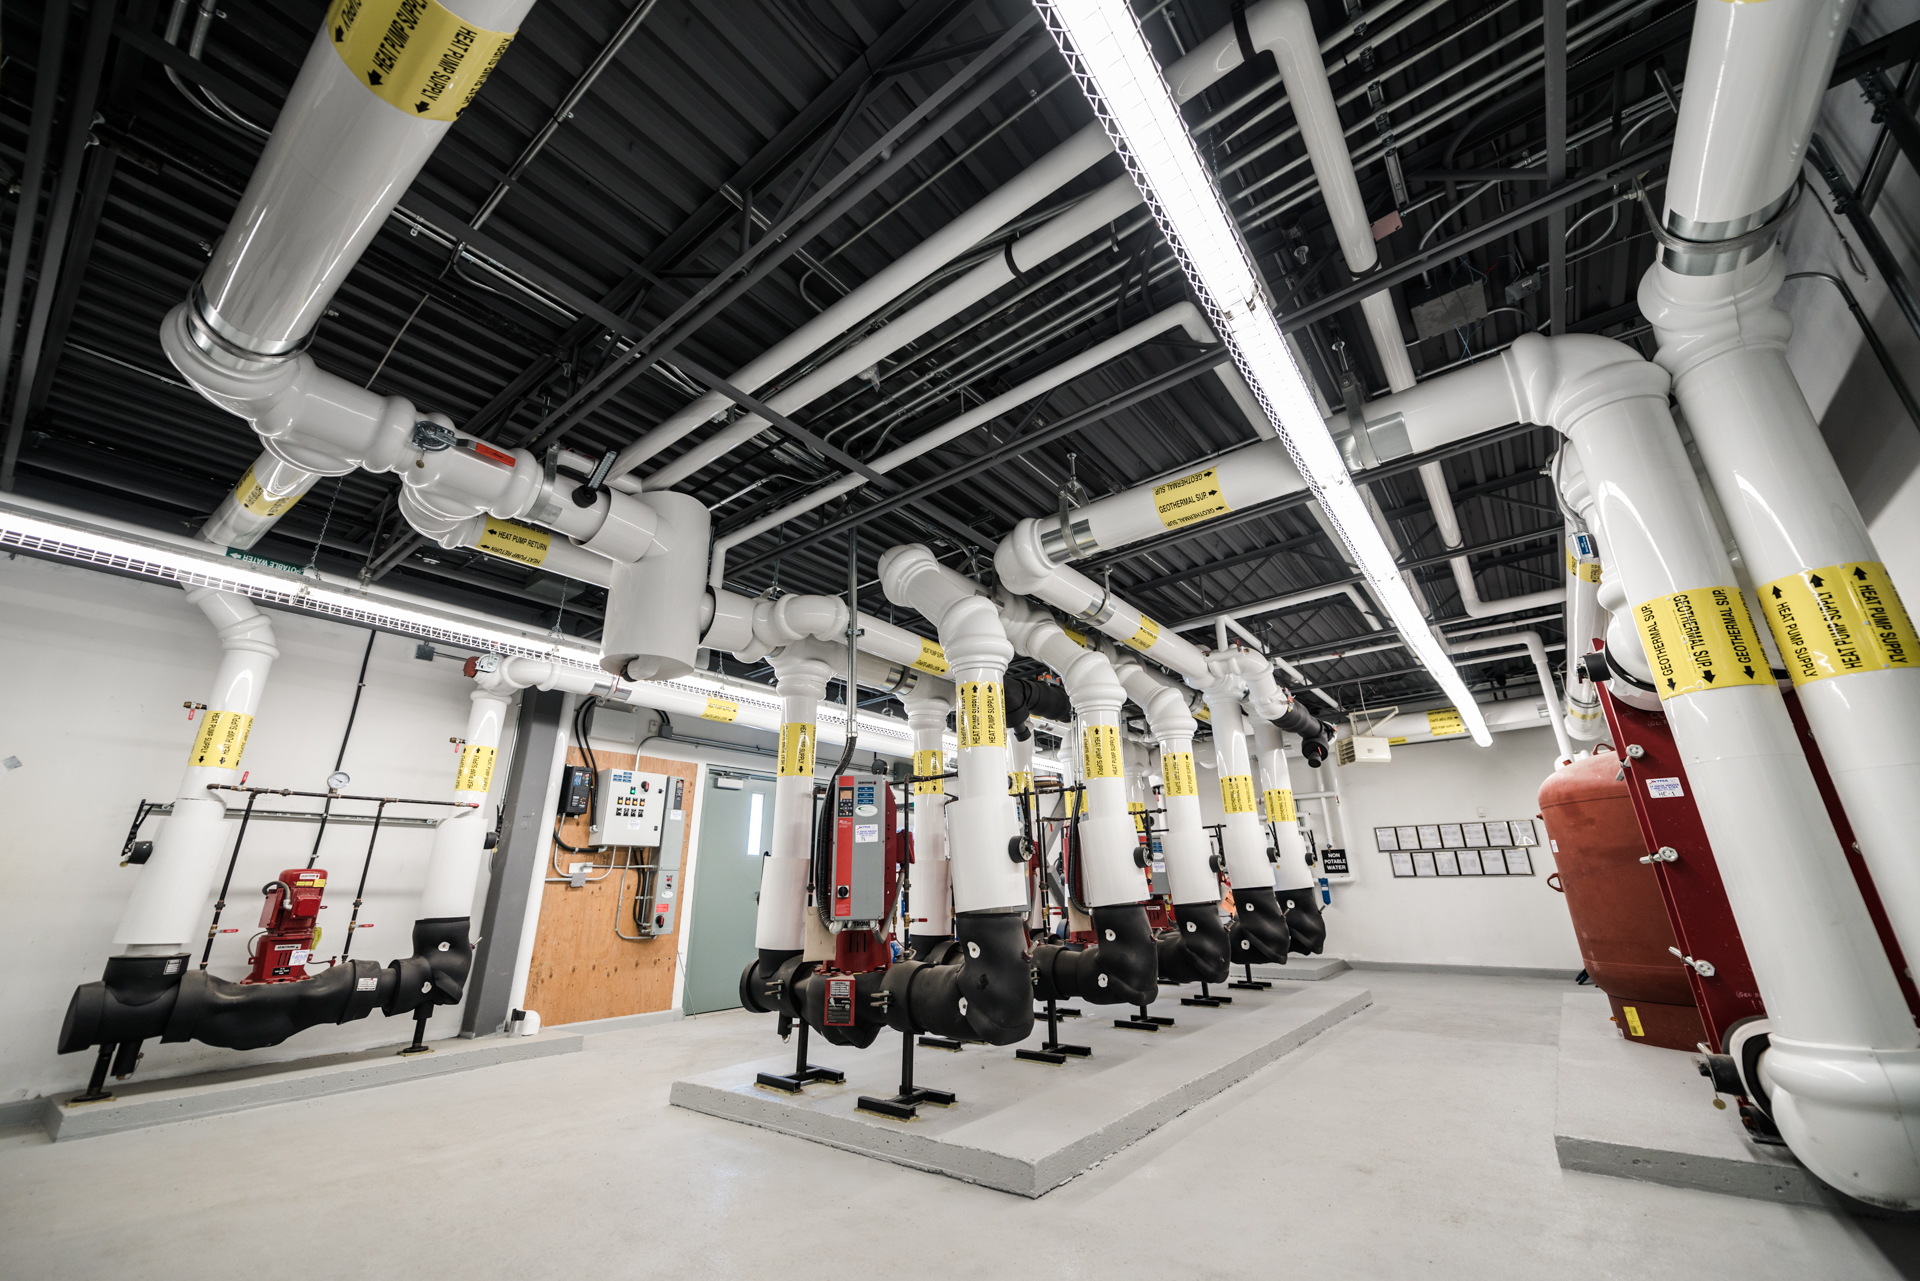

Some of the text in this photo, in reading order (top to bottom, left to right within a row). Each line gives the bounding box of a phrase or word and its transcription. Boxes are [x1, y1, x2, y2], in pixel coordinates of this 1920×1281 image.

[383, 19, 410, 54] PUMP
[372, 42, 398, 74] HEAT
[421, 26, 478, 101] HEAT PUMP SUPPLY
[1158, 496, 1196, 514] GEOTHERMAL
[498, 530, 548, 552] HEAT PUMP RETURN
[242, 554, 268, 566] WATER
[1858, 584, 1882, 605] HEAT
[1673, 594, 1706, 650] GEOTHERMAL
[1694, 650, 1712, 668] SUP.
[1712, 589, 1752, 664] GEOTHERMAL SUP.
[1813, 592, 1864, 670] HEAT PUMP SUPPLY
[1868, 607, 1893, 630] PUMP
[1641, 604, 1674, 676] GEOTHERMAL SUP.
[1776, 602, 1818, 678] HEAT PUMP SUPPLY
[1880, 632, 1908, 664] SUPPLY
